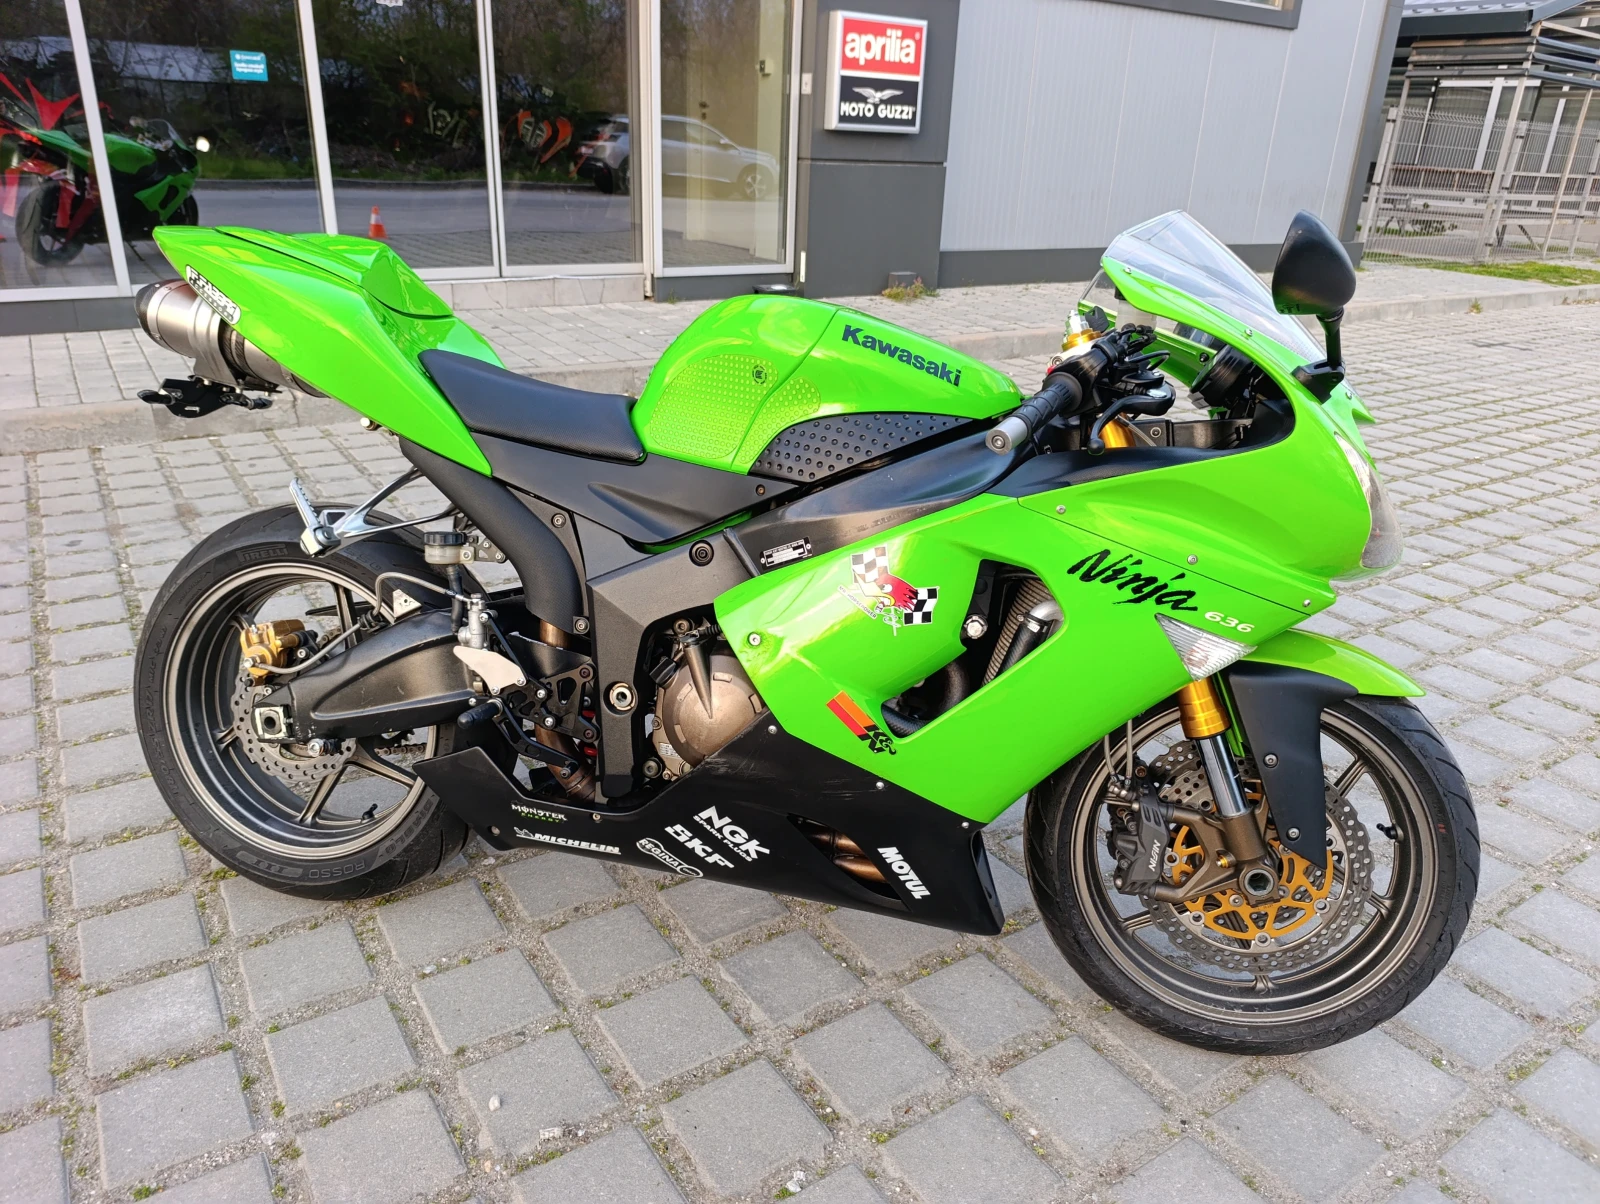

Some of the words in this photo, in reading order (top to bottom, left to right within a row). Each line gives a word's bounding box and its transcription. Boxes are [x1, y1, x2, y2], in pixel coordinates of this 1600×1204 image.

[844, 28, 916, 66] aprilia
[840, 101, 875, 117] MOTO
[877, 104, 912, 120] GUZZI
[841, 324, 962, 388] Kawasaki
[235, 544, 288, 563] PIRELLI
[1067, 549, 1198, 611] Ninja
[1204, 611, 1256, 633] 636
[511, 804, 567, 821] MONSTER
[521, 812, 560, 823] ENERGY
[534, 833, 620, 853] MICHELIN
[664, 824, 735, 869] SKF
[693, 815, 723, 839] SPARK
[723, 839, 753, 862] PLUGS
[698, 805, 770, 859] NGK
[639, 838, 681, 868] REGINA
[1148, 839, 1161, 872] NISSIN
[308, 860, 367, 879] ROSSO
[877, 846, 931, 899] MOTUL
